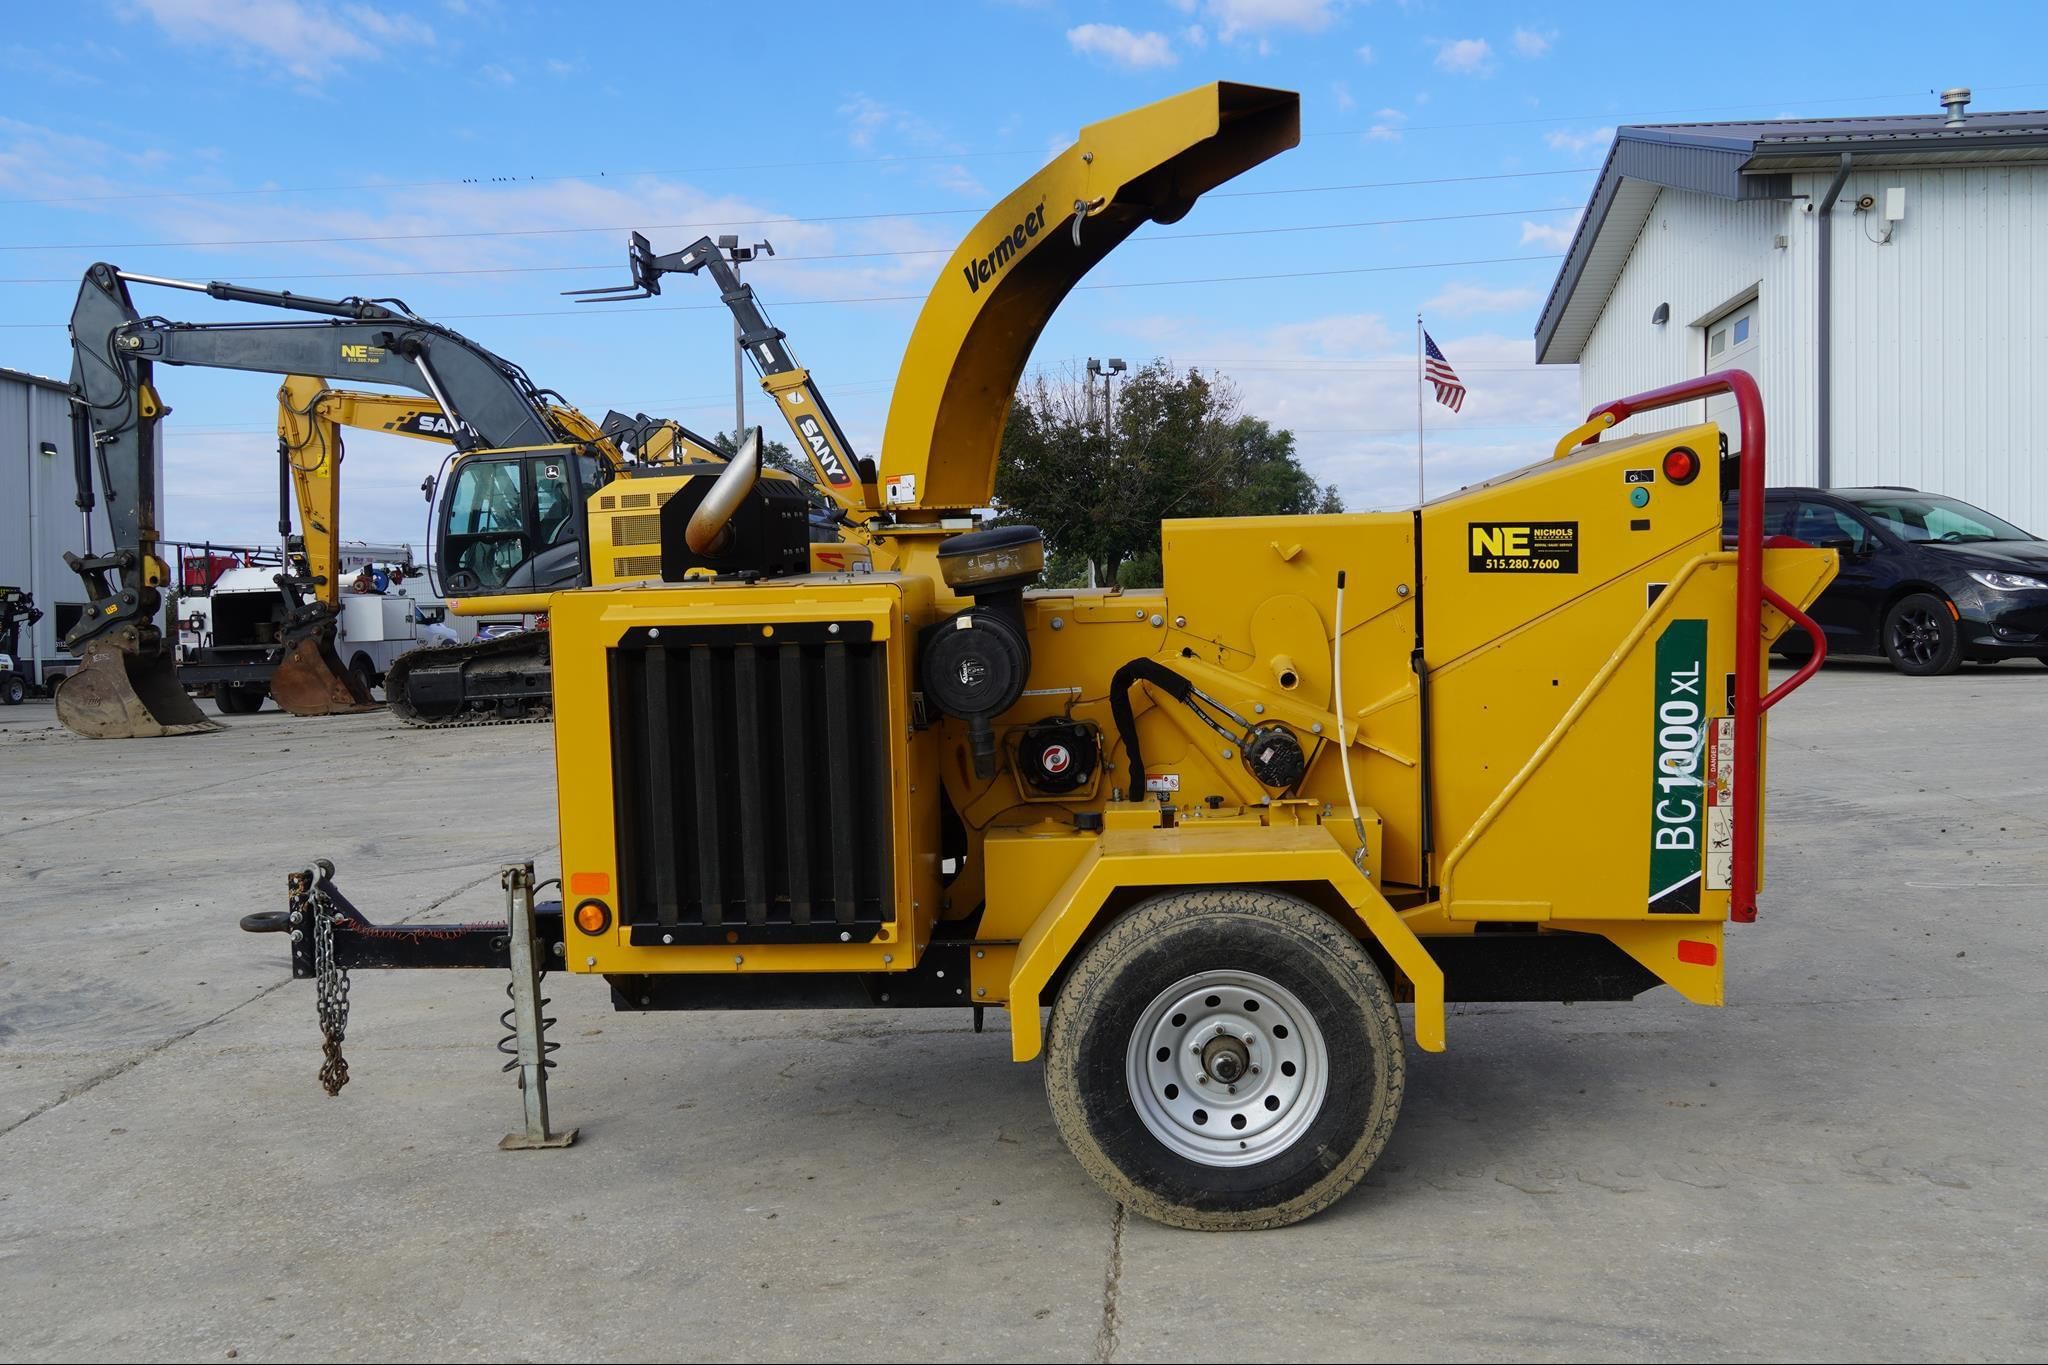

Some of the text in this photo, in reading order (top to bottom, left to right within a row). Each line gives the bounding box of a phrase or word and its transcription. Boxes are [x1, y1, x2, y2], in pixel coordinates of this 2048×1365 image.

[963, 202, 1045, 294] Vermeer
[341, 344, 368, 358] NE
[800, 419, 844, 476] SANY
[1472, 527, 1531, 556] NE
[1533, 528, 1574, 537] NICHOLS
[1485, 559, 1560, 569] 515.280.7600
[1710, 744, 1718, 773] DANGER
